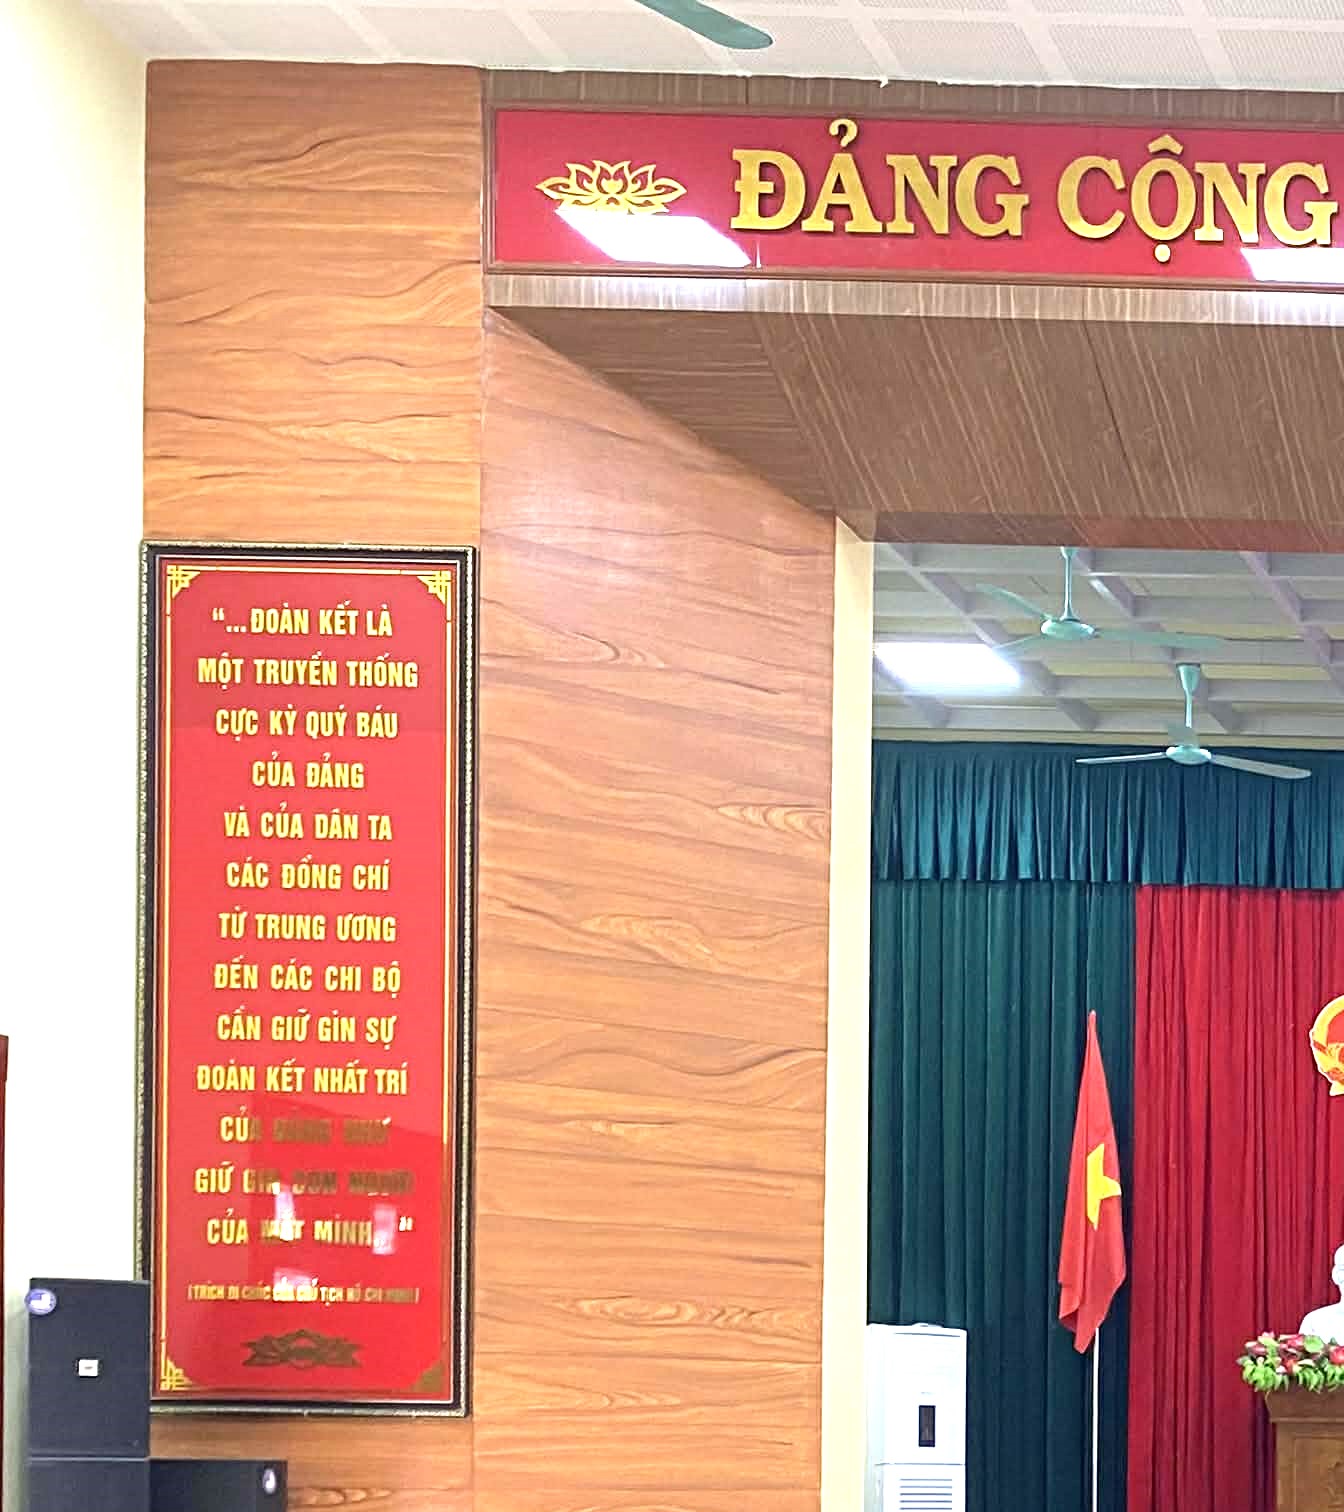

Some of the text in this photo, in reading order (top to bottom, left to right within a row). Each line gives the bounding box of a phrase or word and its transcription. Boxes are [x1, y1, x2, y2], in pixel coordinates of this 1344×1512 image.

[731, 119, 1029, 236] ĐẢNG
[1060, 135, 1338, 263] CỘNG
[319, 600, 359, 635] KẾT
[366, 604, 392, 636] LÀ
[198, 652, 243, 690] MỘT
[346, 653, 418, 687] THỐNG
[216, 708, 258, 741] CỰC
[306, 705, 346, 738] QUÝ
[357, 705, 398, 738] BÁU
[252, 752, 364, 788] CỦA ĐẢNG
[224, 802, 392, 840] VÀ CỦA DÂN TA
[226, 857, 268, 888] CÁC
[353, 859, 390, 890] CHÍ
[219, 906, 396, 941] TỪ TRUNG ƯƠNG
[214, 955, 401, 998] ĐẾN CÁC CHI BỘ
[271, 1009, 310, 1041] GIỮ
[318, 1009, 355, 1042] GÌN
[366, 1016, 397, 1049] SỰ
[197, 1058, 408, 1095] ĐOÀN KẾT NHẤT TRÍ
[195, 1161, 234, 1193] GIỮ
[207, 1210, 248, 1245] CỦA
